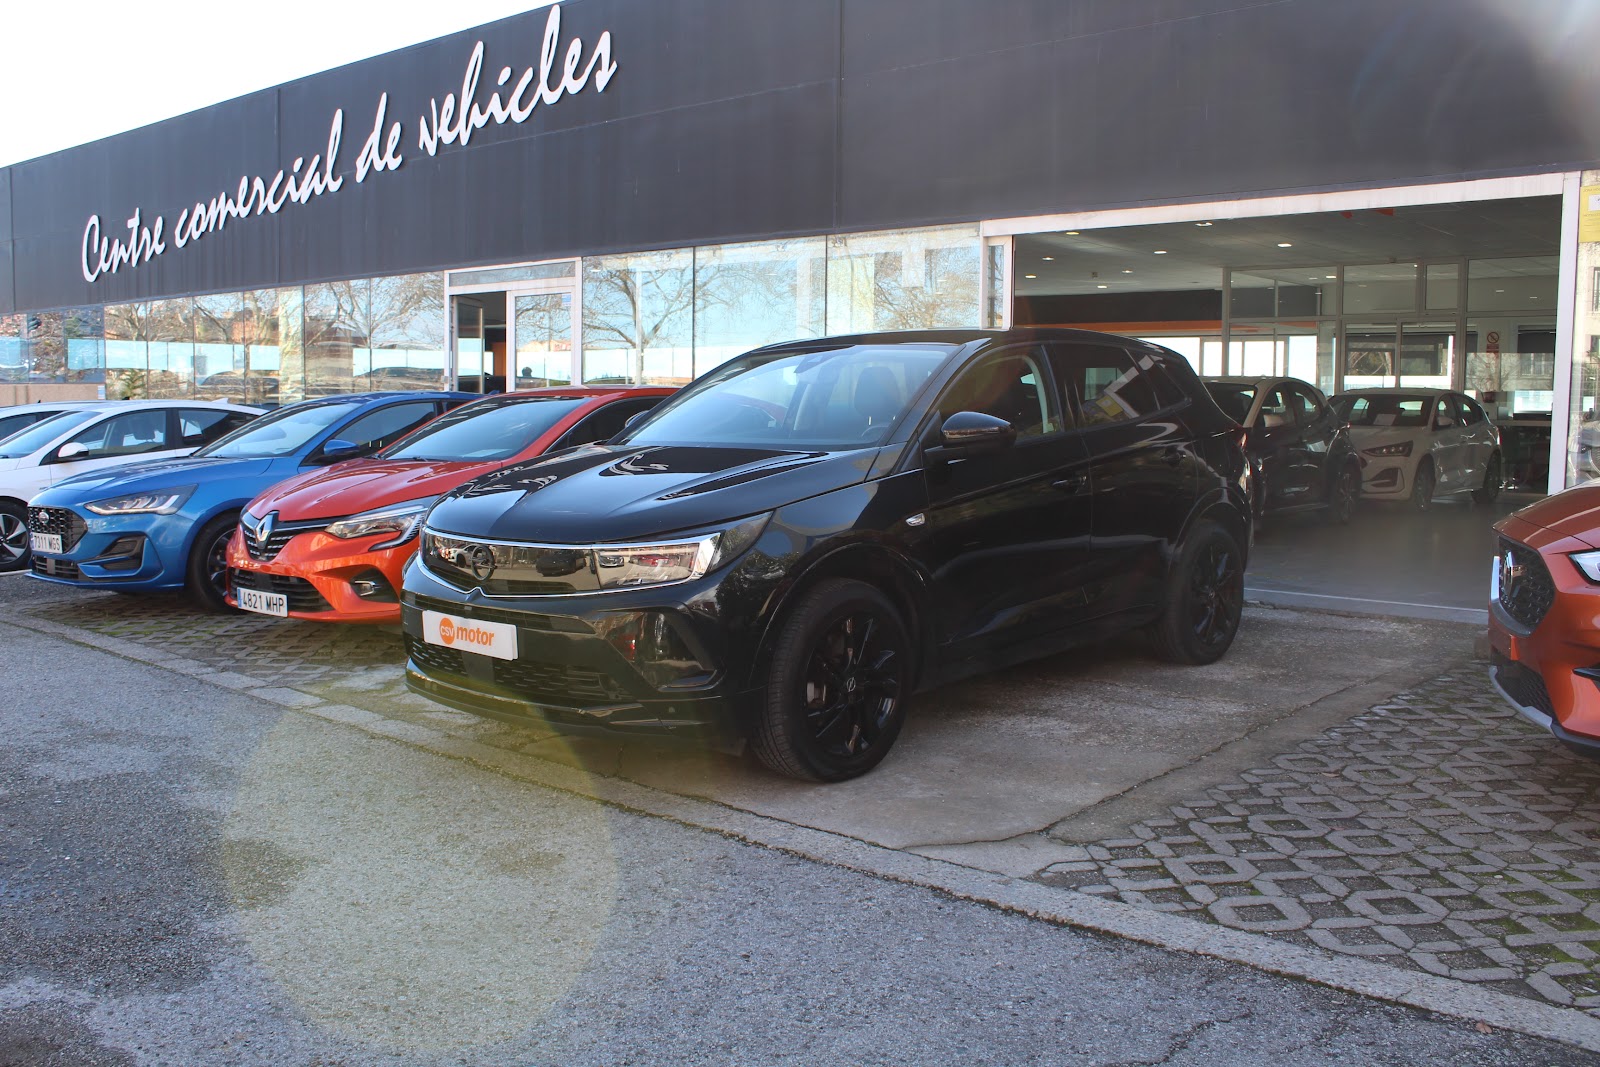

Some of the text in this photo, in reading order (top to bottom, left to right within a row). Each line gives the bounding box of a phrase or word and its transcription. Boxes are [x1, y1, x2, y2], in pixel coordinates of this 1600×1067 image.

[82, 4, 618, 283] Centre comercial de vehicles
[243, 592, 285, 613] 4821 MHP
[456, 626, 495, 646] motor
